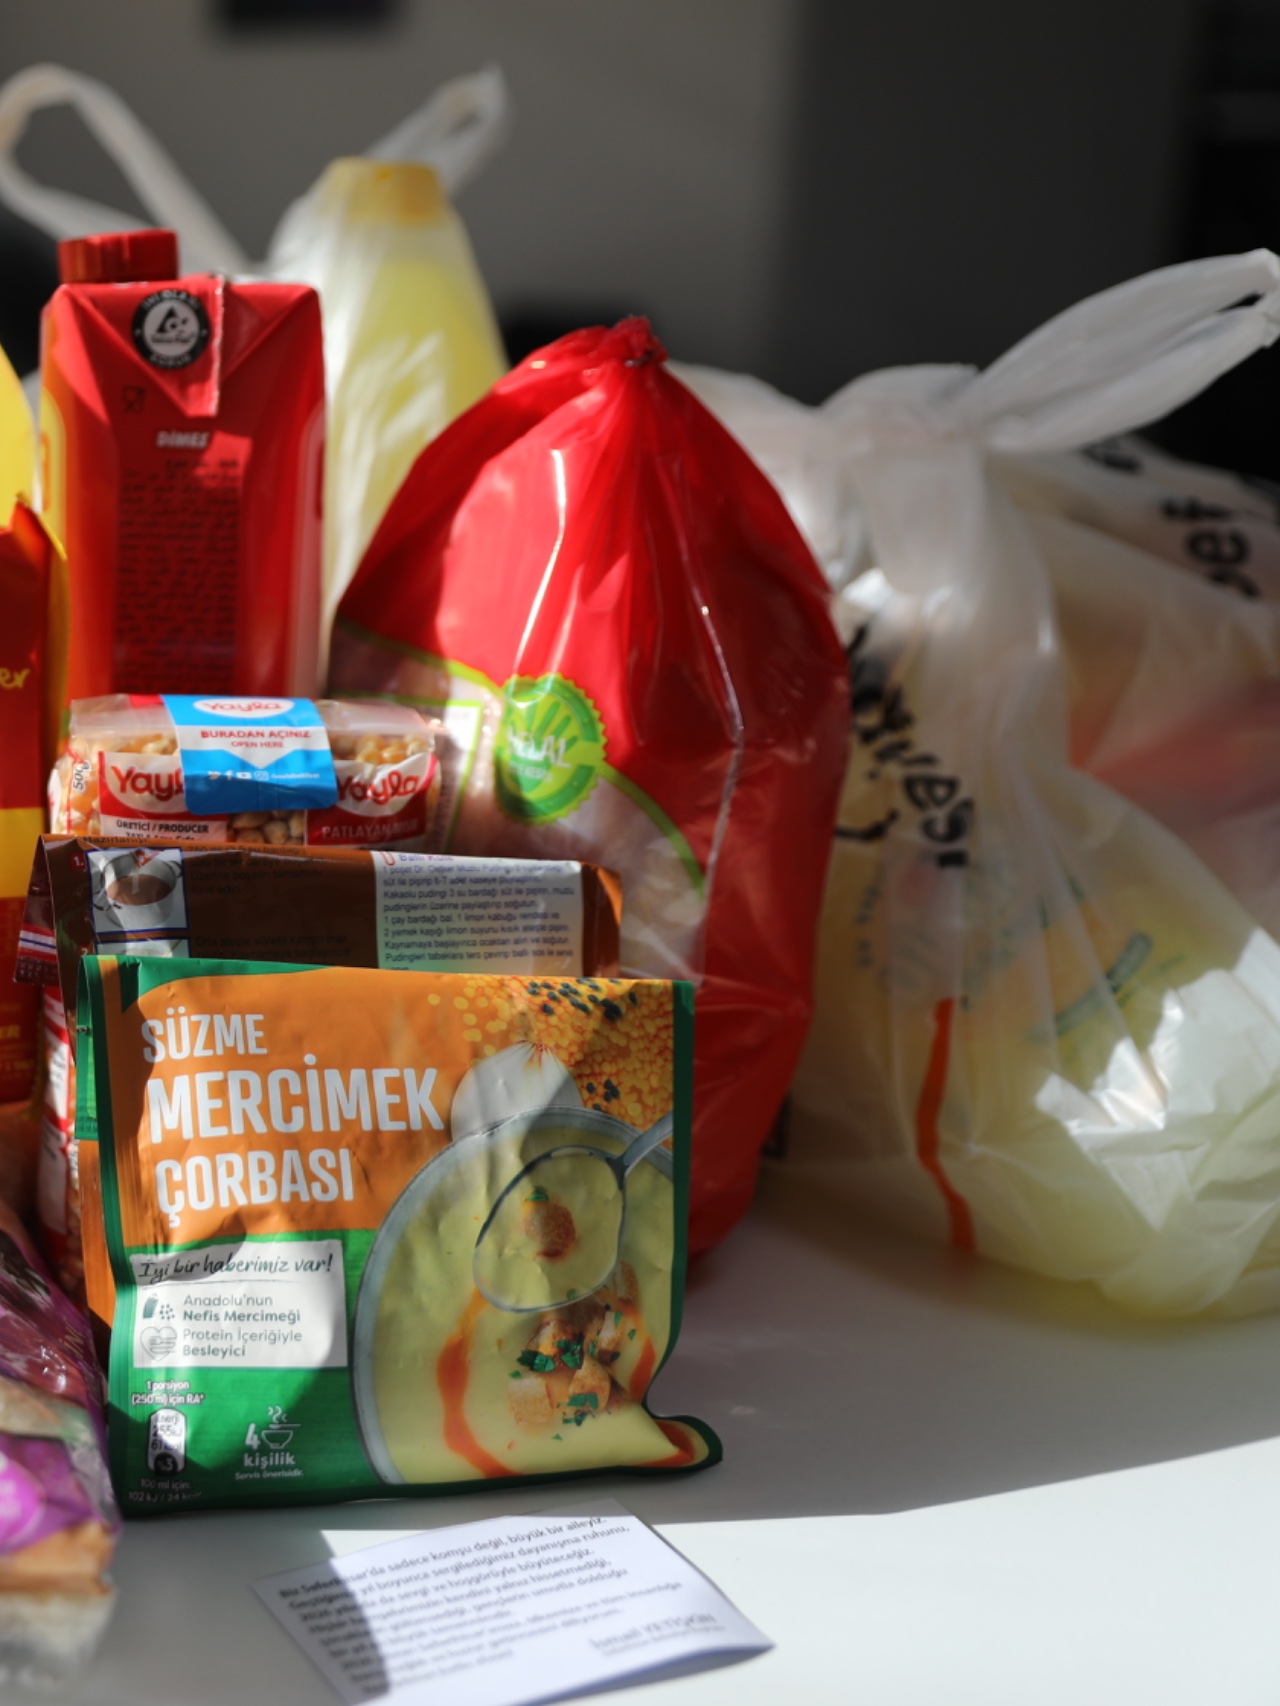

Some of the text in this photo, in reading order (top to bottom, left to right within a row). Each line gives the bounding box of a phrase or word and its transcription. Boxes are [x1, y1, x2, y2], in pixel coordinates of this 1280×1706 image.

[200, 730, 311, 740] BURADAN AÇINIZ
[158, 822, 209, 833] PRODUCER
[322, 825, 391, 838] PATLAYAN
[141, 1006, 268, 1063] SÜZME
[147, 1053, 445, 1144] MERCİMEK
[155, 1148, 354, 1228] ÇORBASI
[138, 1251, 333, 1284] İyi bir haberimiz var!
[183, 1294, 273, 1307] Anadolu'nun
[183, 1309, 301, 1324] Nefis Mercimeği
[183, 1325, 302, 1345] Protein İçeriğiyle
[183, 1345, 246, 1359] Besleyici
[152, 1380, 190, 1392] porsiyon
[169, 1394, 185, 1405] için
[245, 1423, 260, 1449] 4
[244, 1452, 296, 1469] kişilik
[235, 1469, 304, 1480] Servis önerisidir.
